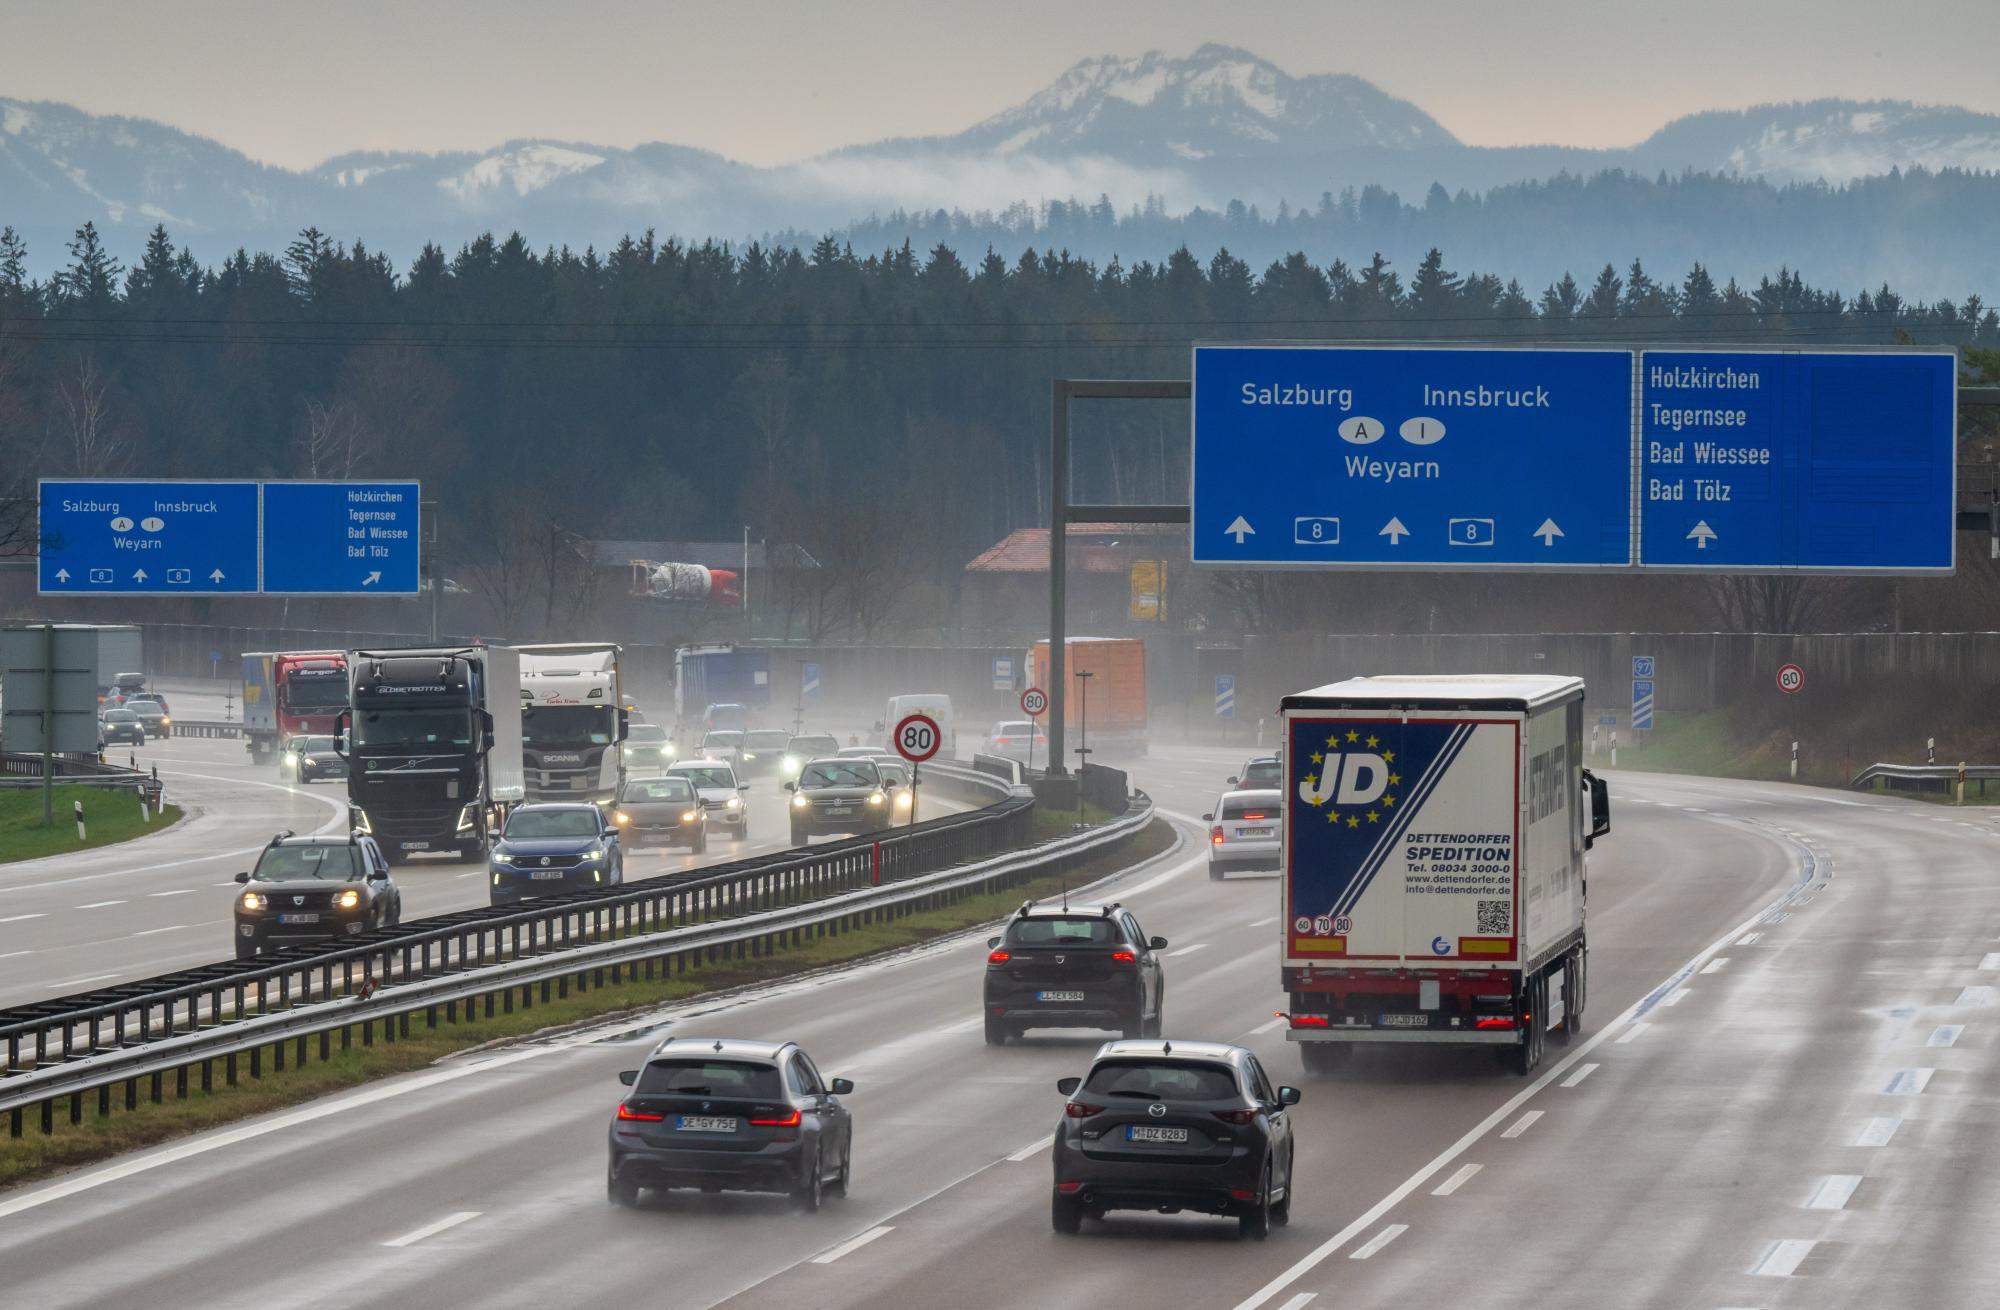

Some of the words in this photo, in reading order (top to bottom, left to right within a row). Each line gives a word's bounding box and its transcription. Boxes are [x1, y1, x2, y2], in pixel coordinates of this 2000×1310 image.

[1651, 366, 1760, 389] Holzkirchen
[1242, 383, 1351, 411] Salzburg
[1424, 384, 1550, 407] Innsbruck
[1651, 403, 1746, 431] Tegernsee
[1355, 423, 1368, 439] A
[1420, 423, 1425, 440] I
[1650, 441, 1684, 464] Bad
[1694, 441, 1770, 465] Wiessee
[1345, 456, 1440, 483] Weyarn
[1650, 478, 1684, 501] Bad
[1694, 478, 1731, 501] Tölz
[348, 490, 402, 503] Holzkirchen
[63, 500, 120, 514] Salzburg
[154, 501, 218, 513] Innsbruck
[348, 509, 396, 523] Tegernsee
[118, 520, 126, 529] A
[1312, 523, 1322, 539] 8
[348, 527, 365, 539] Bad
[370, 527, 408, 539] Wiessee
[1466, 524, 1476, 540] 8
[114, 537, 162, 551] Weyarn
[348, 545, 365, 558] Bad
[370, 545, 389, 558] Tölz
[98, 571, 104, 580] 8
[176, 571, 181, 580] 8
[1637, 662, 1649, 673] 97
[1782, 672, 1798, 686] 80
[1026, 695, 1042, 708] 80
[904, 727, 931, 749] 80
[544, 754, 580, 762] SCANIA
[1299, 752, 1390, 805] JD
[1406, 834, 1511, 844] DETTENDORFER
[1405, 847, 1511, 861] SPEDITION
[1407, 864, 1427, 873] Tel.
[1431, 864, 1467, 873] 08034
[1470, 864, 1511, 873] 3000-0
[1405, 874, 1511, 884] www.dettendorfer.de
[1405, 885, 1511, 895] info@dettendorfer.de
[1298, 920, 1309, 930] 60
[1317, 918, 1330, 931] 70
[1336, 918, 1349, 931] 80
[1411, 1016, 1426, 1025] 162
[1146, 1128, 1159, 1139] DZ
[1161, 1128, 1186, 1140] 8283
